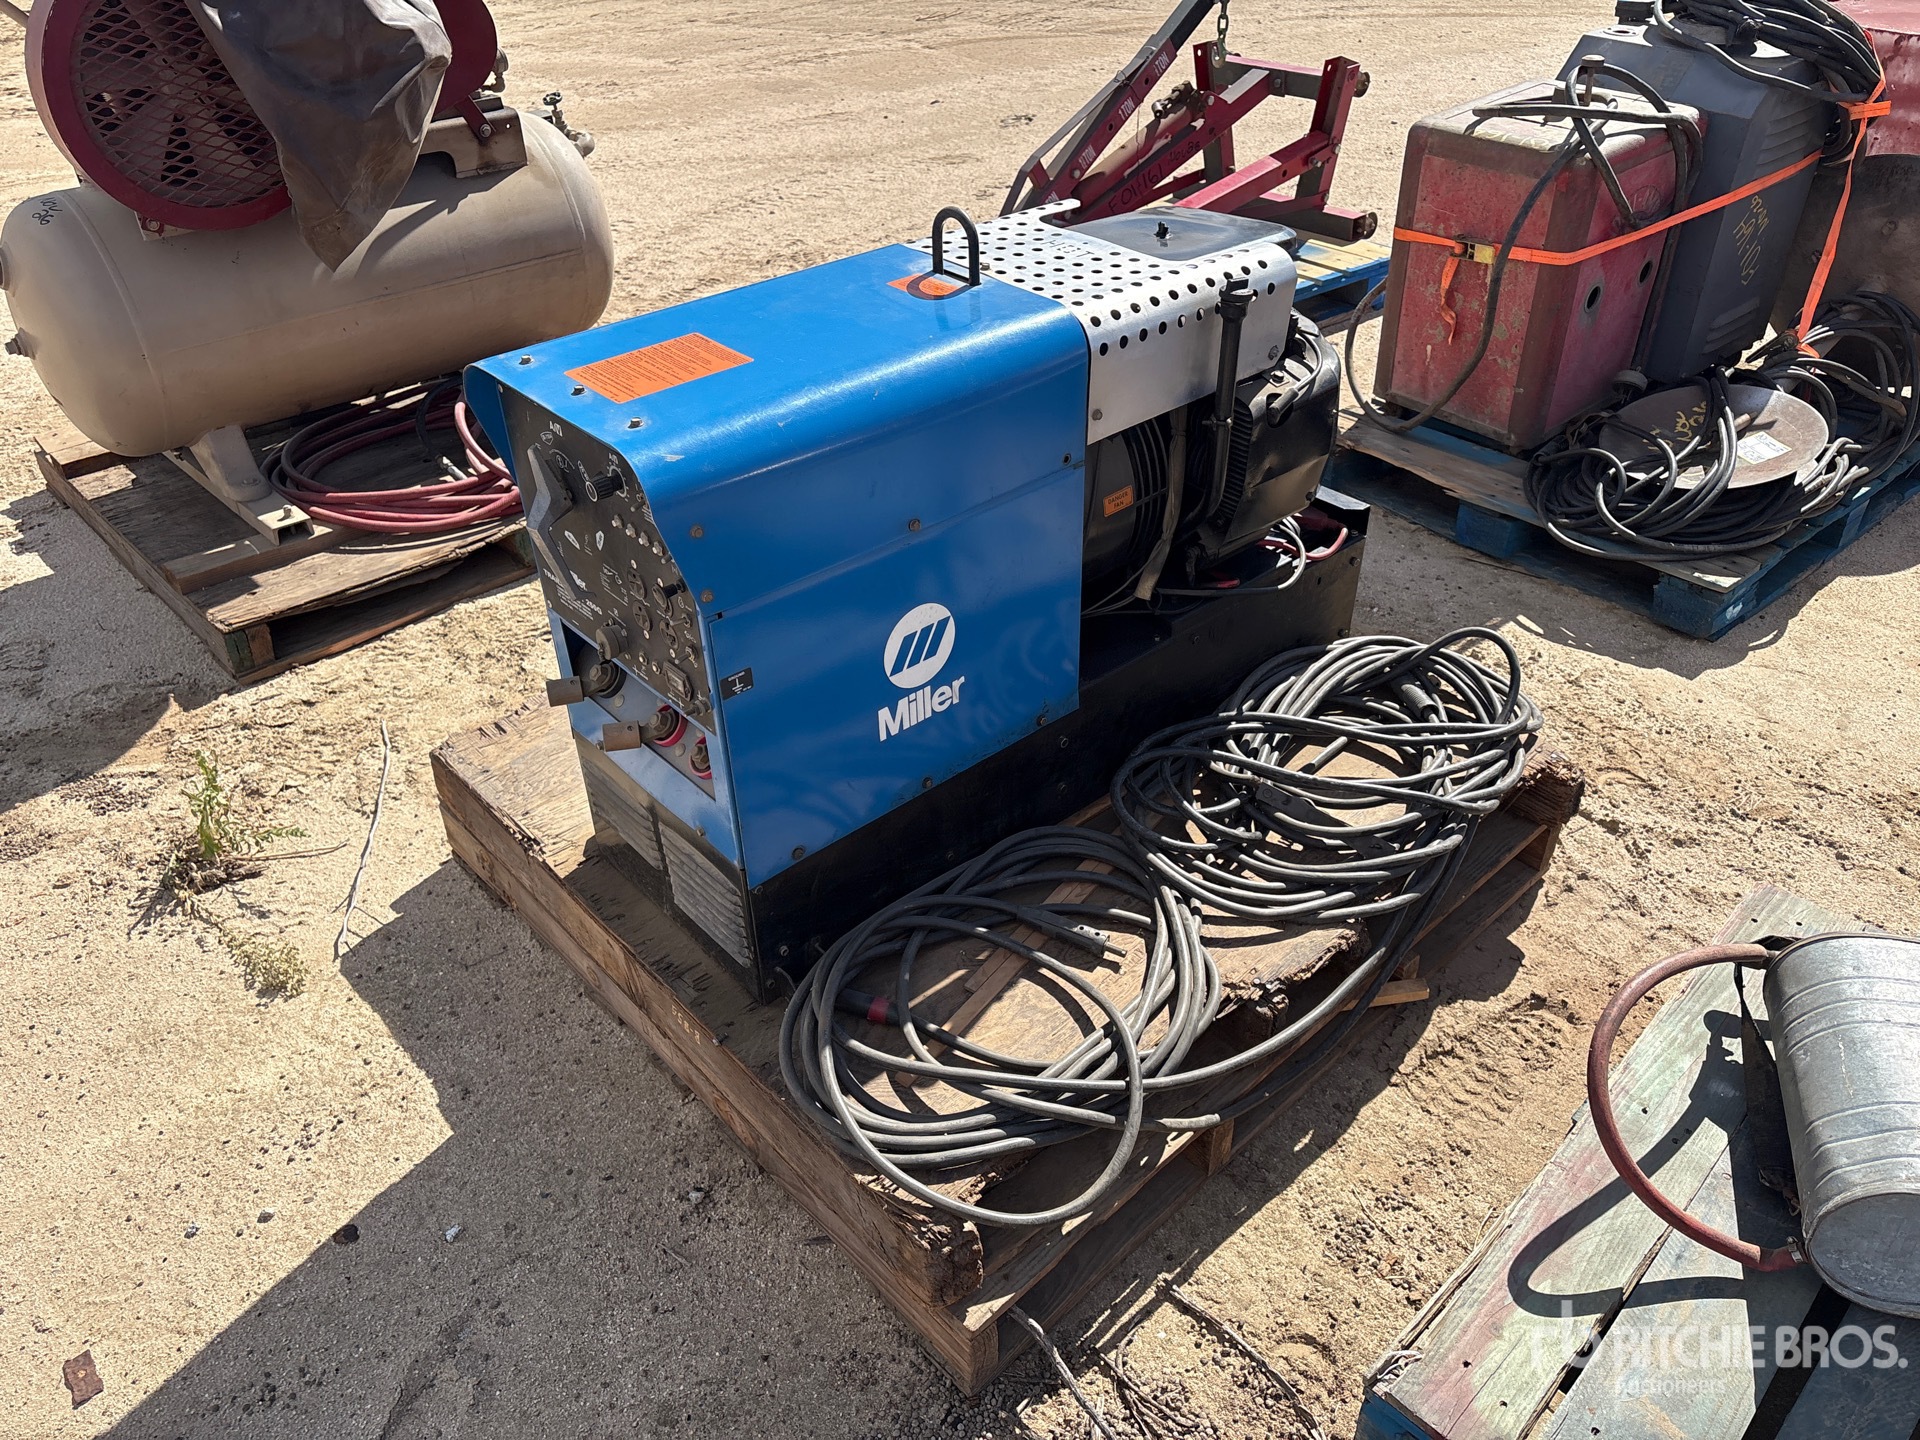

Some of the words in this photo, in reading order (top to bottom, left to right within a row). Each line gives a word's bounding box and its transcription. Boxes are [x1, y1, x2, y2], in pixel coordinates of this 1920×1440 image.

[1155, 51, 1170, 73] TON
[1121, 96, 1135, 117] TON
[1081, 145, 1096, 165] TON
[32, 209, 54, 226] 26
[1040, 239, 1095, 258] HOT
[1107, 491, 1128, 504] DANGER
[1113, 500, 1124, 509] FAN
[878, 675, 965, 742] Miller
